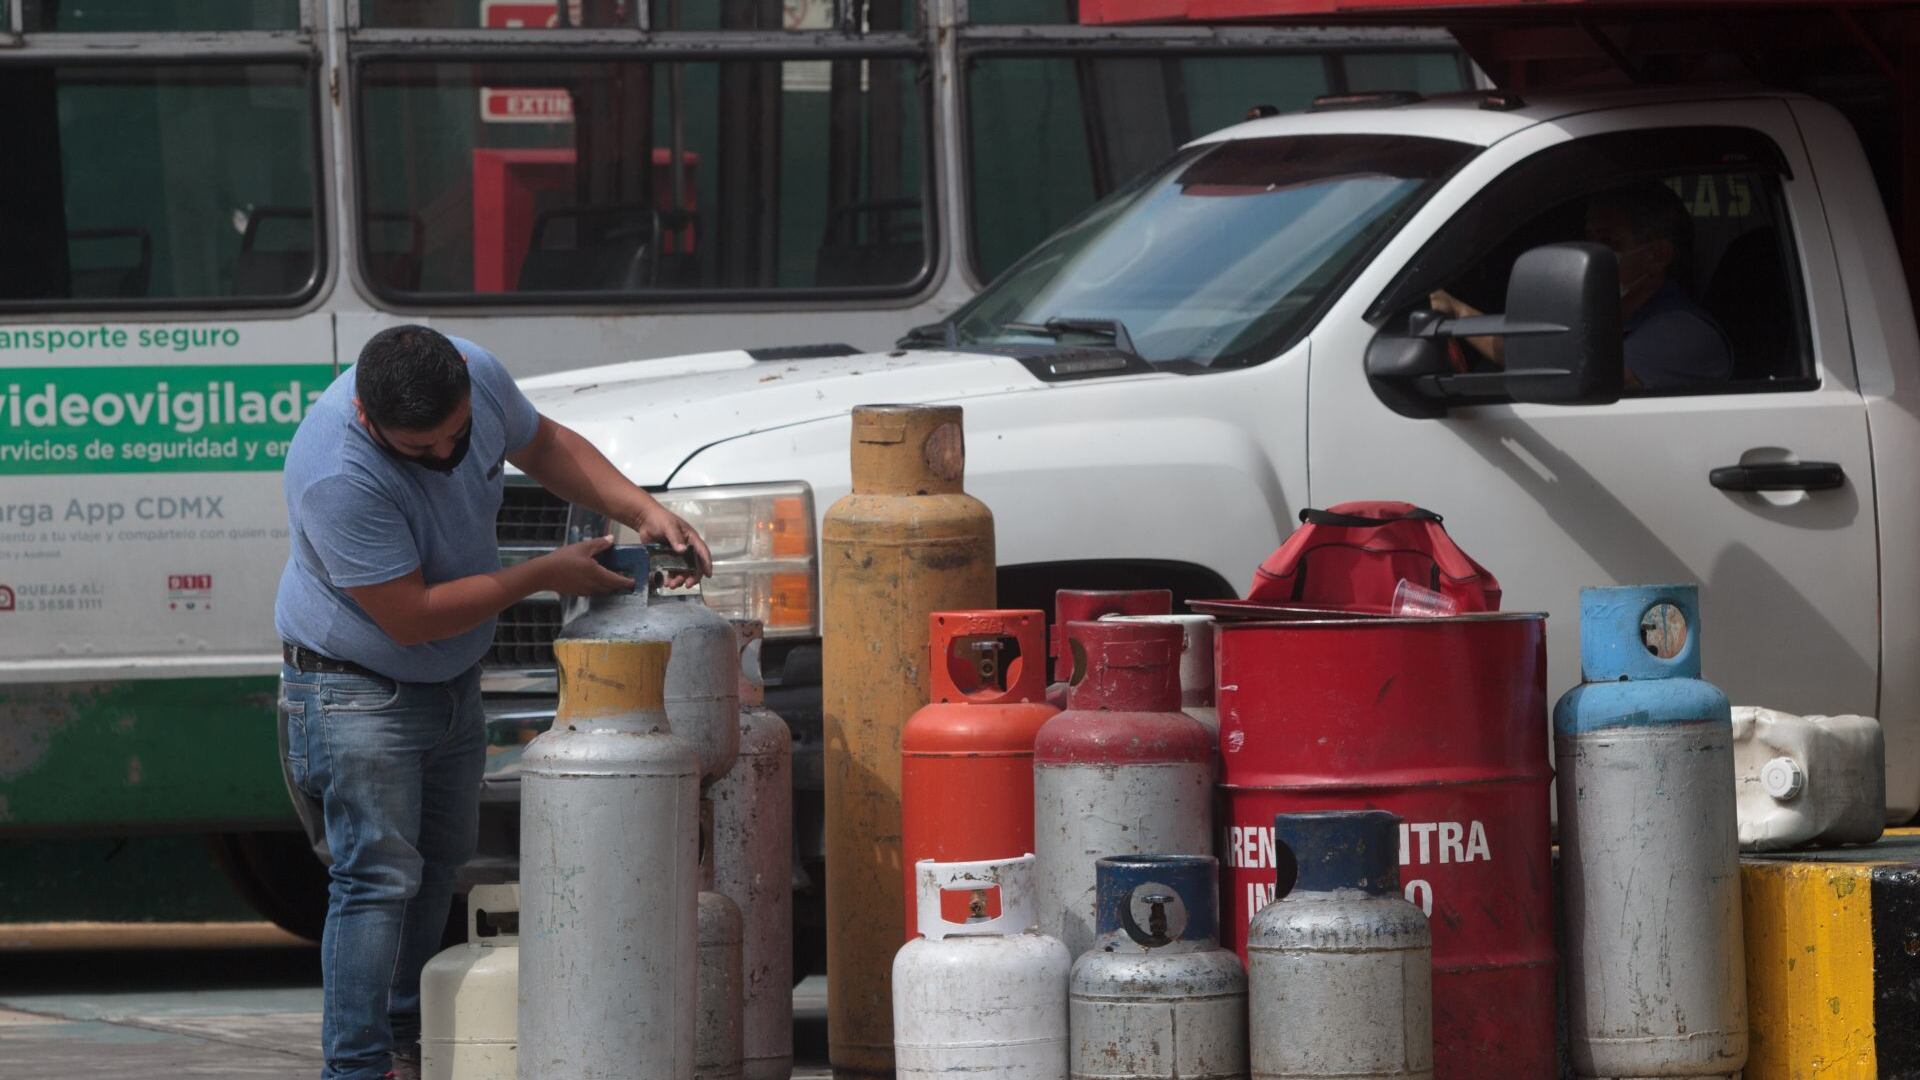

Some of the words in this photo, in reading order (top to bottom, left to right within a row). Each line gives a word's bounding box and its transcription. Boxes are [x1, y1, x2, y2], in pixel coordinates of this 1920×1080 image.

[0, 326, 128, 353] ansporte
[139, 326, 240, 351] seguro
[0, 380, 322, 433] ideovigilad
[84, 438, 115, 459] de
[121, 437, 238, 462] seguridad
[244, 441, 258, 461] y
[64, 497, 125, 525] App
[135, 496, 224, 521] CDMX
[40, 532, 48, 542] a
[52, 530, 66, 542] tu
[70, 529, 101, 544] viaje
[106, 531, 114, 542] y
[200, 528, 225, 540] con
[229, 527, 266, 541] quien
[17, 583, 77, 596] QUEJAS
[1222, 827, 1277, 869] AREN
[1400, 820, 1491, 866] TRA
